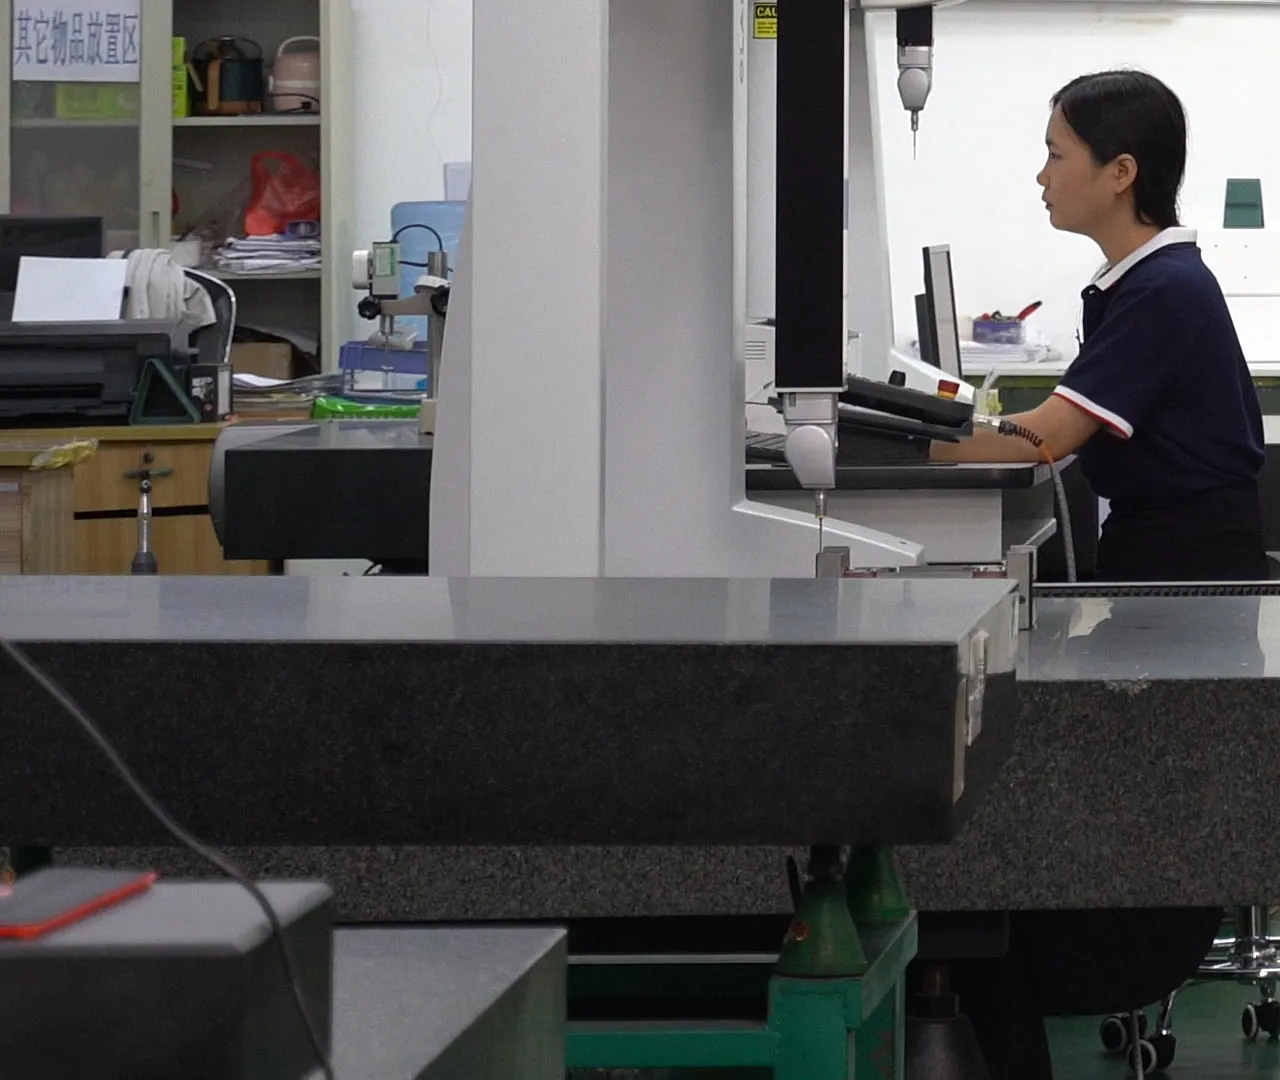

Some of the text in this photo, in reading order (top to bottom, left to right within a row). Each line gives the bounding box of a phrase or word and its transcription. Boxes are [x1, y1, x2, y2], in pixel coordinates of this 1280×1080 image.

[14, 10, 139, 66] 其它物品放置区
